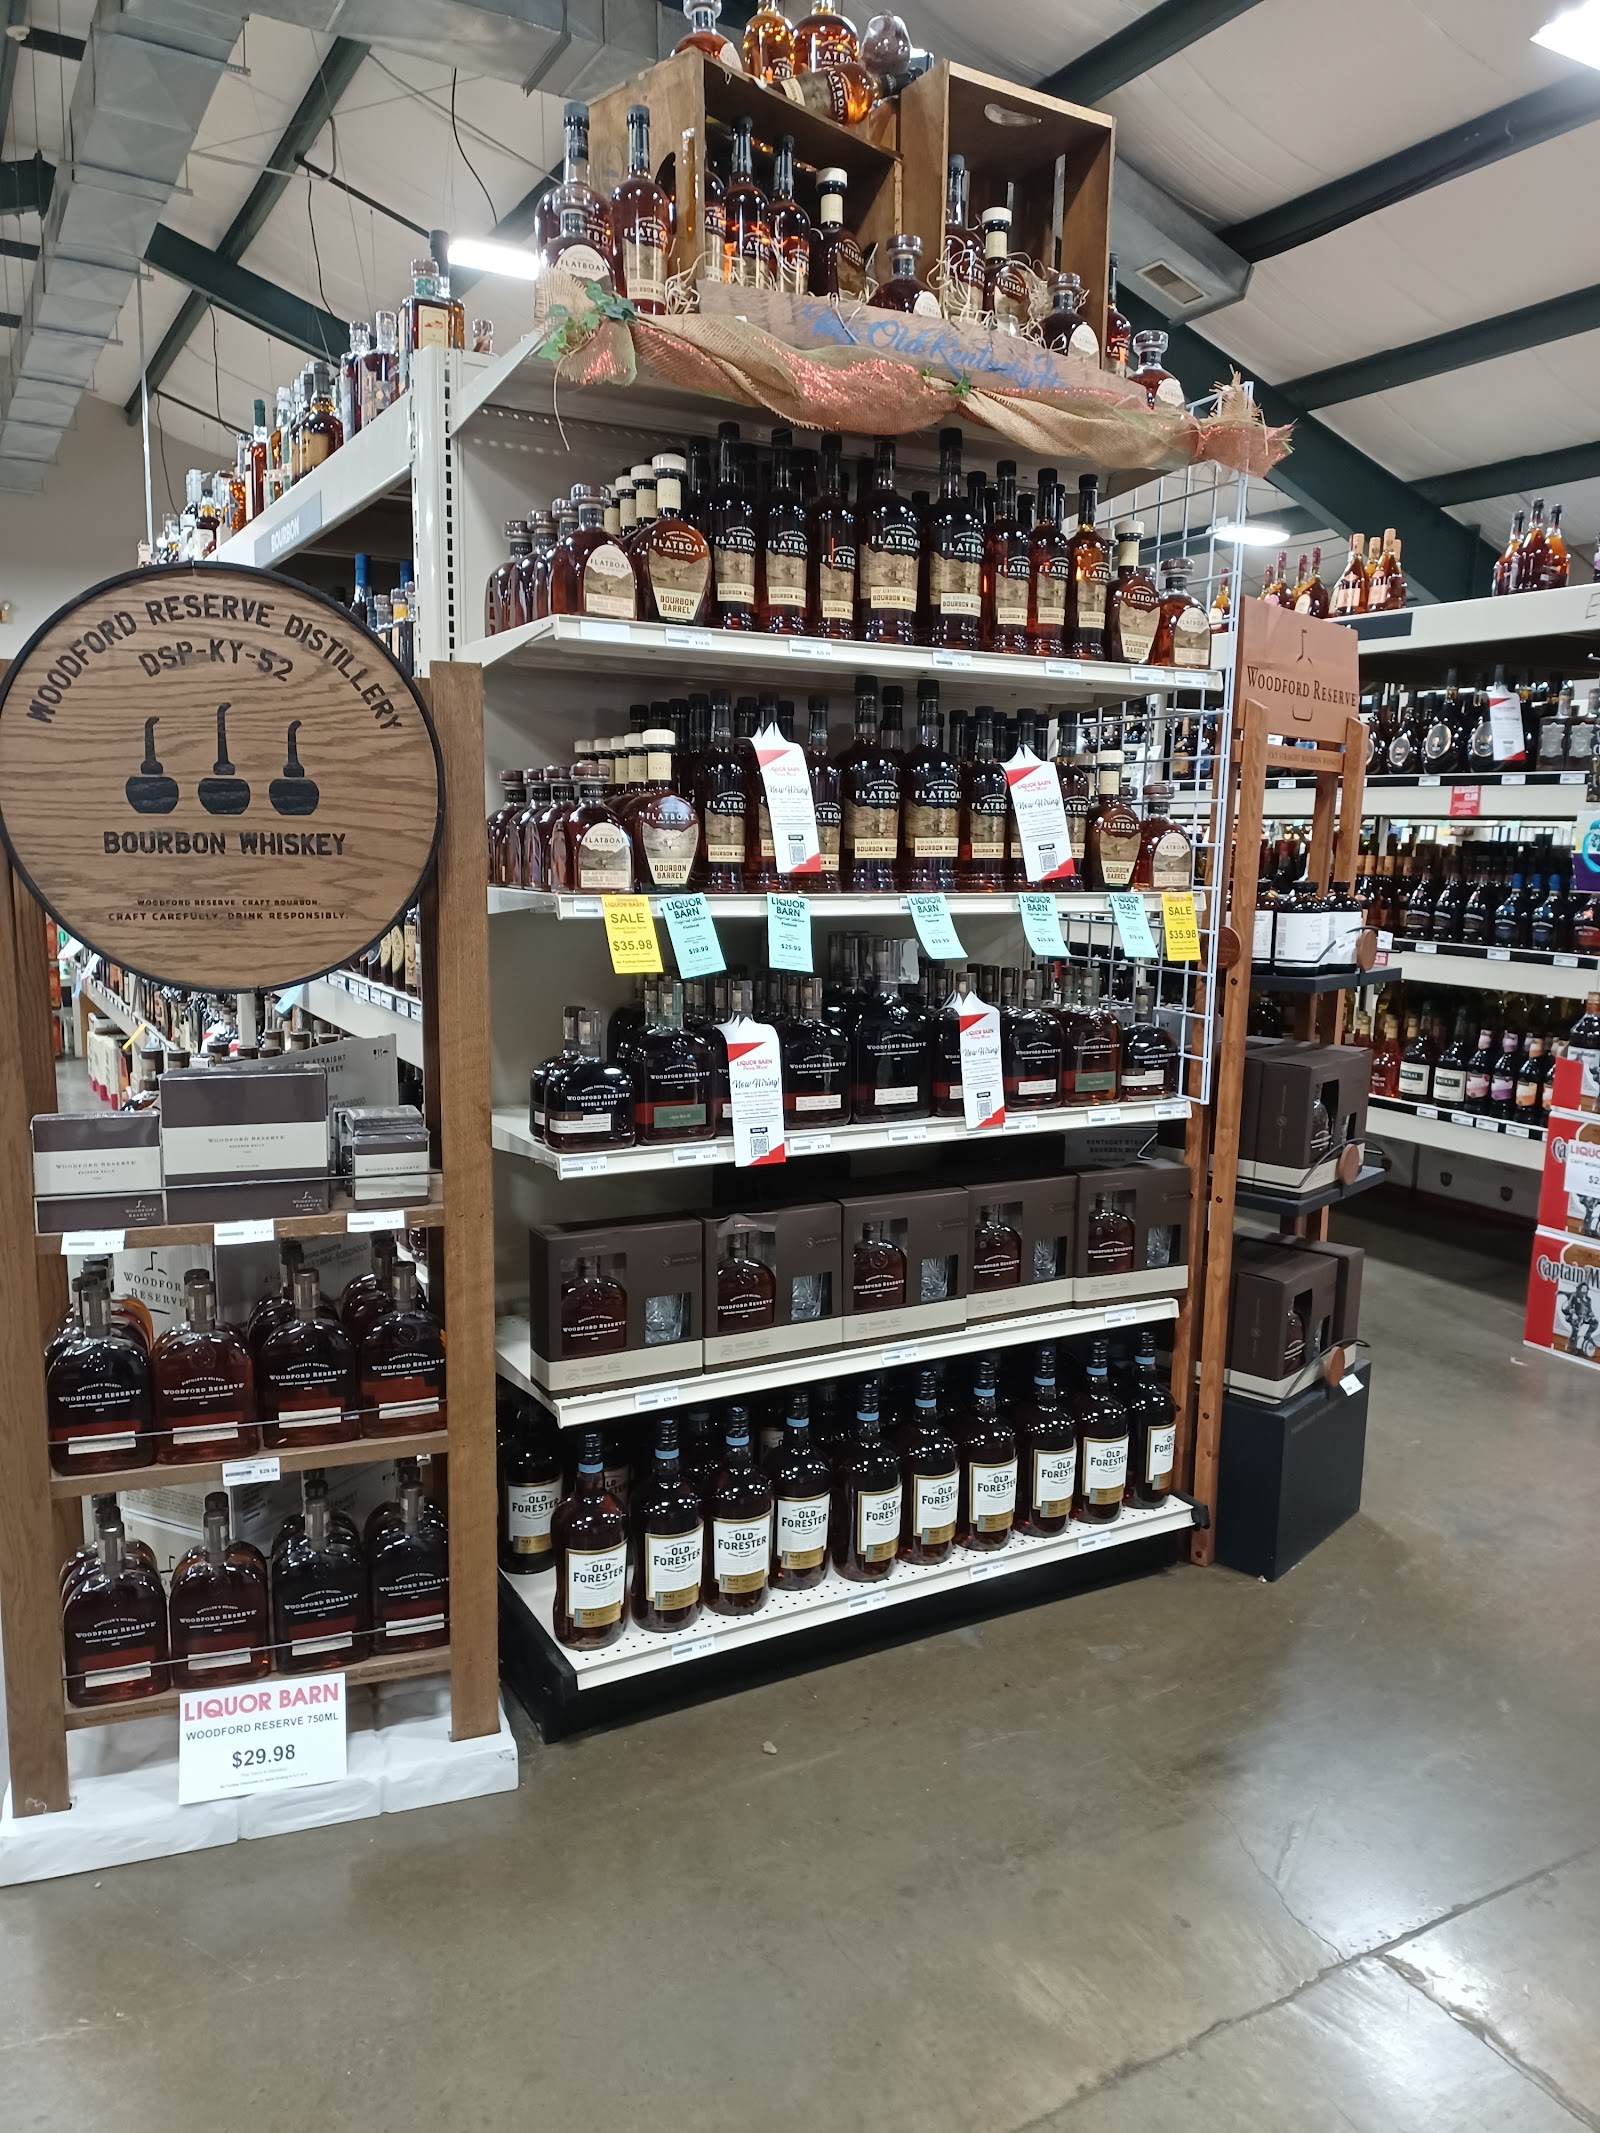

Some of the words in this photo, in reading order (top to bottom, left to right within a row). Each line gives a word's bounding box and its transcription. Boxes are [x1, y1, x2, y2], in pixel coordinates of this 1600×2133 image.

[561, 260, 605, 271] FLATBOAT
[868, 320, 926, 355] Old
[271, 516, 300, 552] BOURBON
[653, 539, 705, 552] FLATBOAT
[591, 559, 629, 569] FLATBOAT
[660, 596, 694, 606] BOURBON
[1123, 592, 1159, 603] FLATBOAT
[663, 604, 690, 614] BARREL
[1125, 640, 1148, 648] BOURBON
[1127, 647, 1145, 655] BARREL
[26, 610, 138, 724] WOODFORD
[147, 594, 276, 628] RESERVE
[284, 614, 403, 731] DISTILLERY
[138, 640, 294, 682] DSP-KY-52
[1247, 666, 1310, 697] WOODFORD
[1314, 680, 1356, 707] RESERVE
[786, 784, 810, 796] Hiring!
[1035, 797, 1061, 808] Hiring!
[647, 812, 695, 820] FLATBOAT
[1104, 822, 1140, 830] FLATBOAT
[103, 831, 226, 854] BOURBON
[239, 832, 346, 856] WHISKEY
[666, 898, 702, 911] LIQUOR
[772, 897, 805, 909] LIQUOR
[910, 896, 942, 905] LIQUOR
[1022, 896, 1051, 904] LIQUOR
[1113, 895, 1139, 904] LIQUOR
[776, 907, 800, 917] BARN
[917, 905, 939, 913] BARN
[1027, 904, 1048, 912] BARN
[1119, 903, 1137, 911] BARN
[1169, 906, 1192, 915] SALE
[228, 912, 263, 920] DRINK
[269, 912, 348, 920] RESPONSIBLY.
[611, 913, 645, 923] SALE
[674, 907, 700, 919] BARN
[1169, 930, 1196, 939] $35.98
[613, 940, 653, 952] $35.98
[689, 946, 709, 955] $19.99
[978, 1045, 999, 1056] Hiring!
[732, 1079, 751, 1088] Now
[752, 1077, 780, 1088] Hiring!
[1537, 1255, 1584, 1283] Captain
[131, 1288, 187, 1307] RESERVE
[749, 1298, 773, 1307] RESERVE
[563, 1324, 598, 1333] WOODFORD
[599, 1321, 627, 1329] RESERVE
[372, 1363, 411, 1371] WOODFORD
[413, 1358, 445, 1367] RESERVE
[269, 1372, 311, 1380] WOODFORD
[313, 1369, 347, 1378] RESERVE
[163, 1387, 206, 1396] WOODFORD
[208, 1383, 244, 1392] RESERVE
[58, 1394, 102, 1402] WOODFORD
[105, 1389, 141, 1399] RESERVE
[1057, 1461, 1070, 1469] OLD
[993, 1475, 1008, 1483] OLD
[938, 1486, 952, 1495] OLD
[528, 1495, 547, 1504] OLD
[882, 1501, 896, 1511] OLD
[782, 1514, 827, 1527] FORESTER
[735, 1533, 753, 1541] OLD
[718, 1536, 767, 1550] FORESTER
[671, 1546, 690, 1556] OLD
[592, 1563, 611, 1572] OLD
[573, 1566, 623, 1583] FORESTER
[379, 1583, 417, 1592] WOODFORD
[284, 1601, 324, 1610] WOODFORD
[326, 1593, 359, 1604] RESERVE
[179, 1615, 220, 1623] WOODFORD
[222, 1610, 257, 1620] RESERVE
[75, 1629, 118, 1638] WOODFORD
[121, 1622, 157, 1633] RESERVE
[184, 1692, 272, 1722] LIQUOR
[279, 1683, 339, 1708] BARN
[186, 1723, 251, 1741] WOODFORD
[254, 1716, 304, 1731] RESERVE
[308, 1712, 339, 1724] 750ML
[232, 1744, 295, 1769] $29.98
